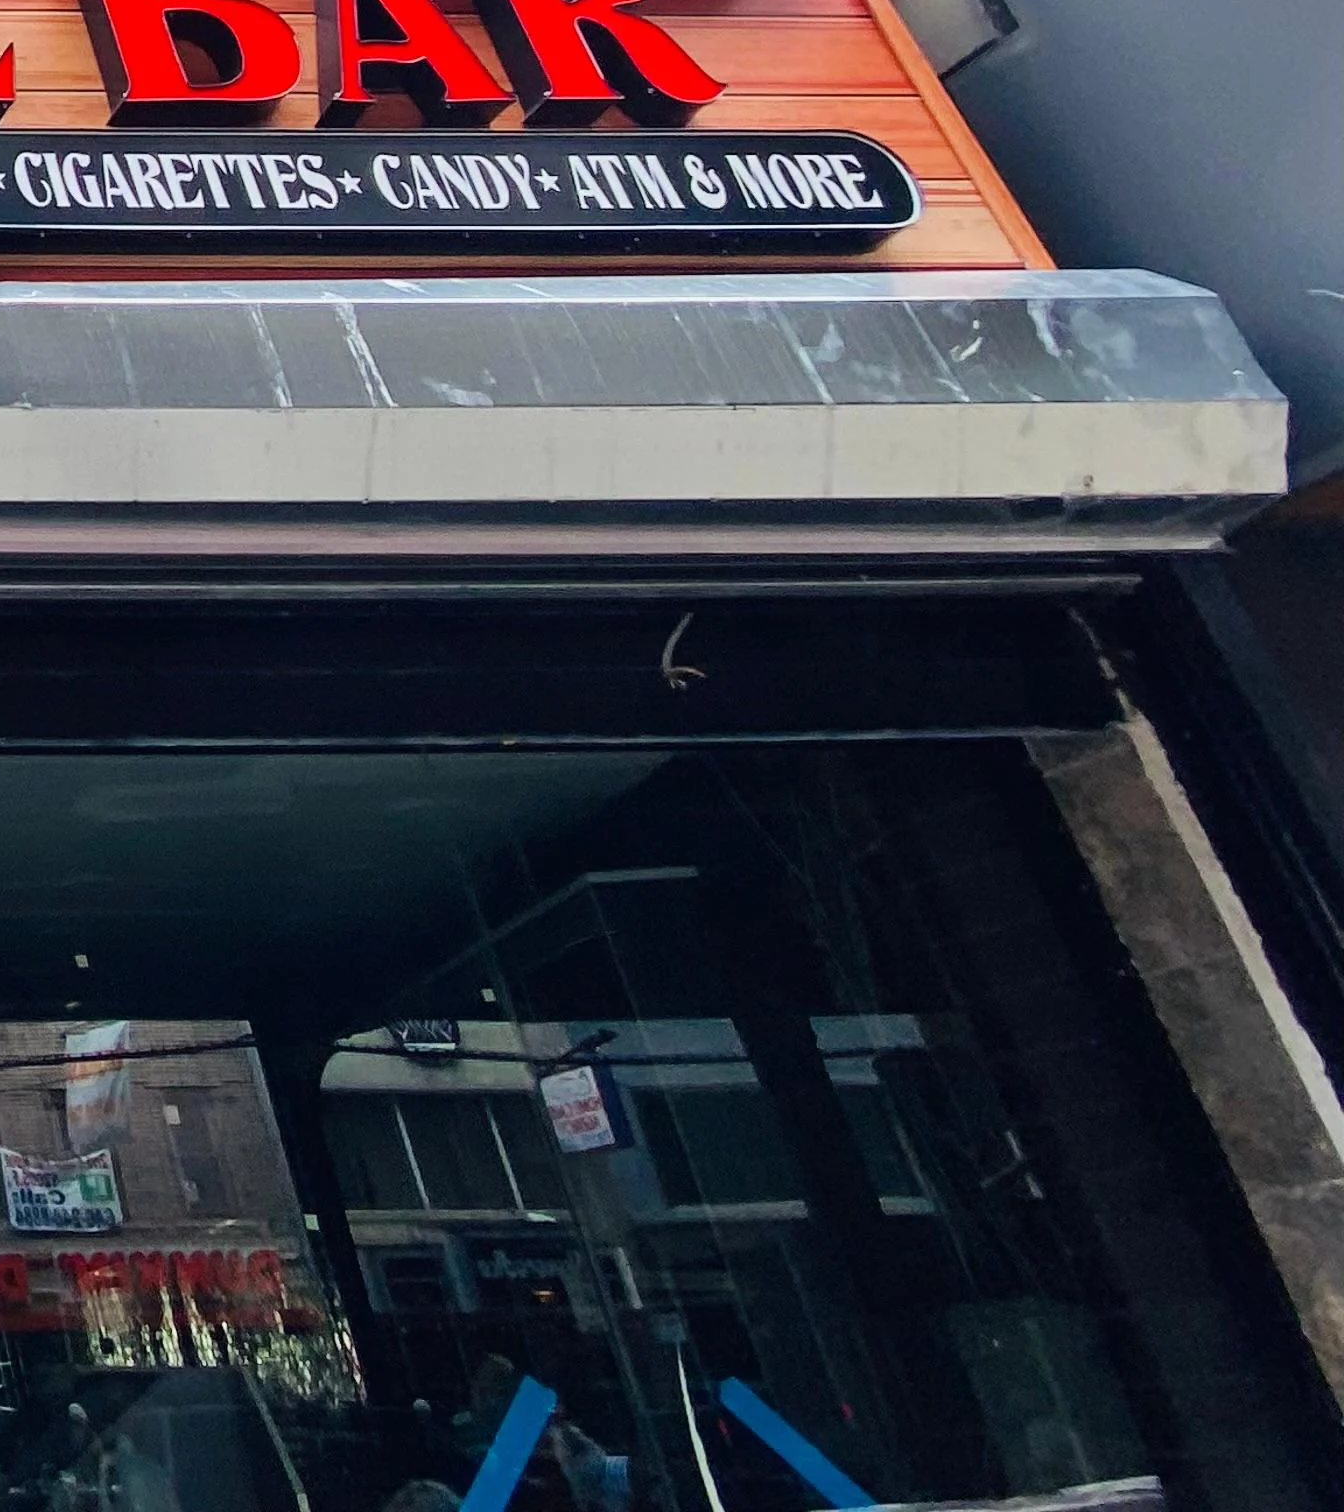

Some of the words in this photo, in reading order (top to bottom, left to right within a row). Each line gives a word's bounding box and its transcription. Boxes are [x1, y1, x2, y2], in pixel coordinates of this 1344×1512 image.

[14, 151, 339, 211] CIGARETTES
[372, 153, 541, 210] CANDY
[568, 154, 686, 210] ATM
[683, 153, 727, 211] &
[724, 153, 884, 210] MORE
